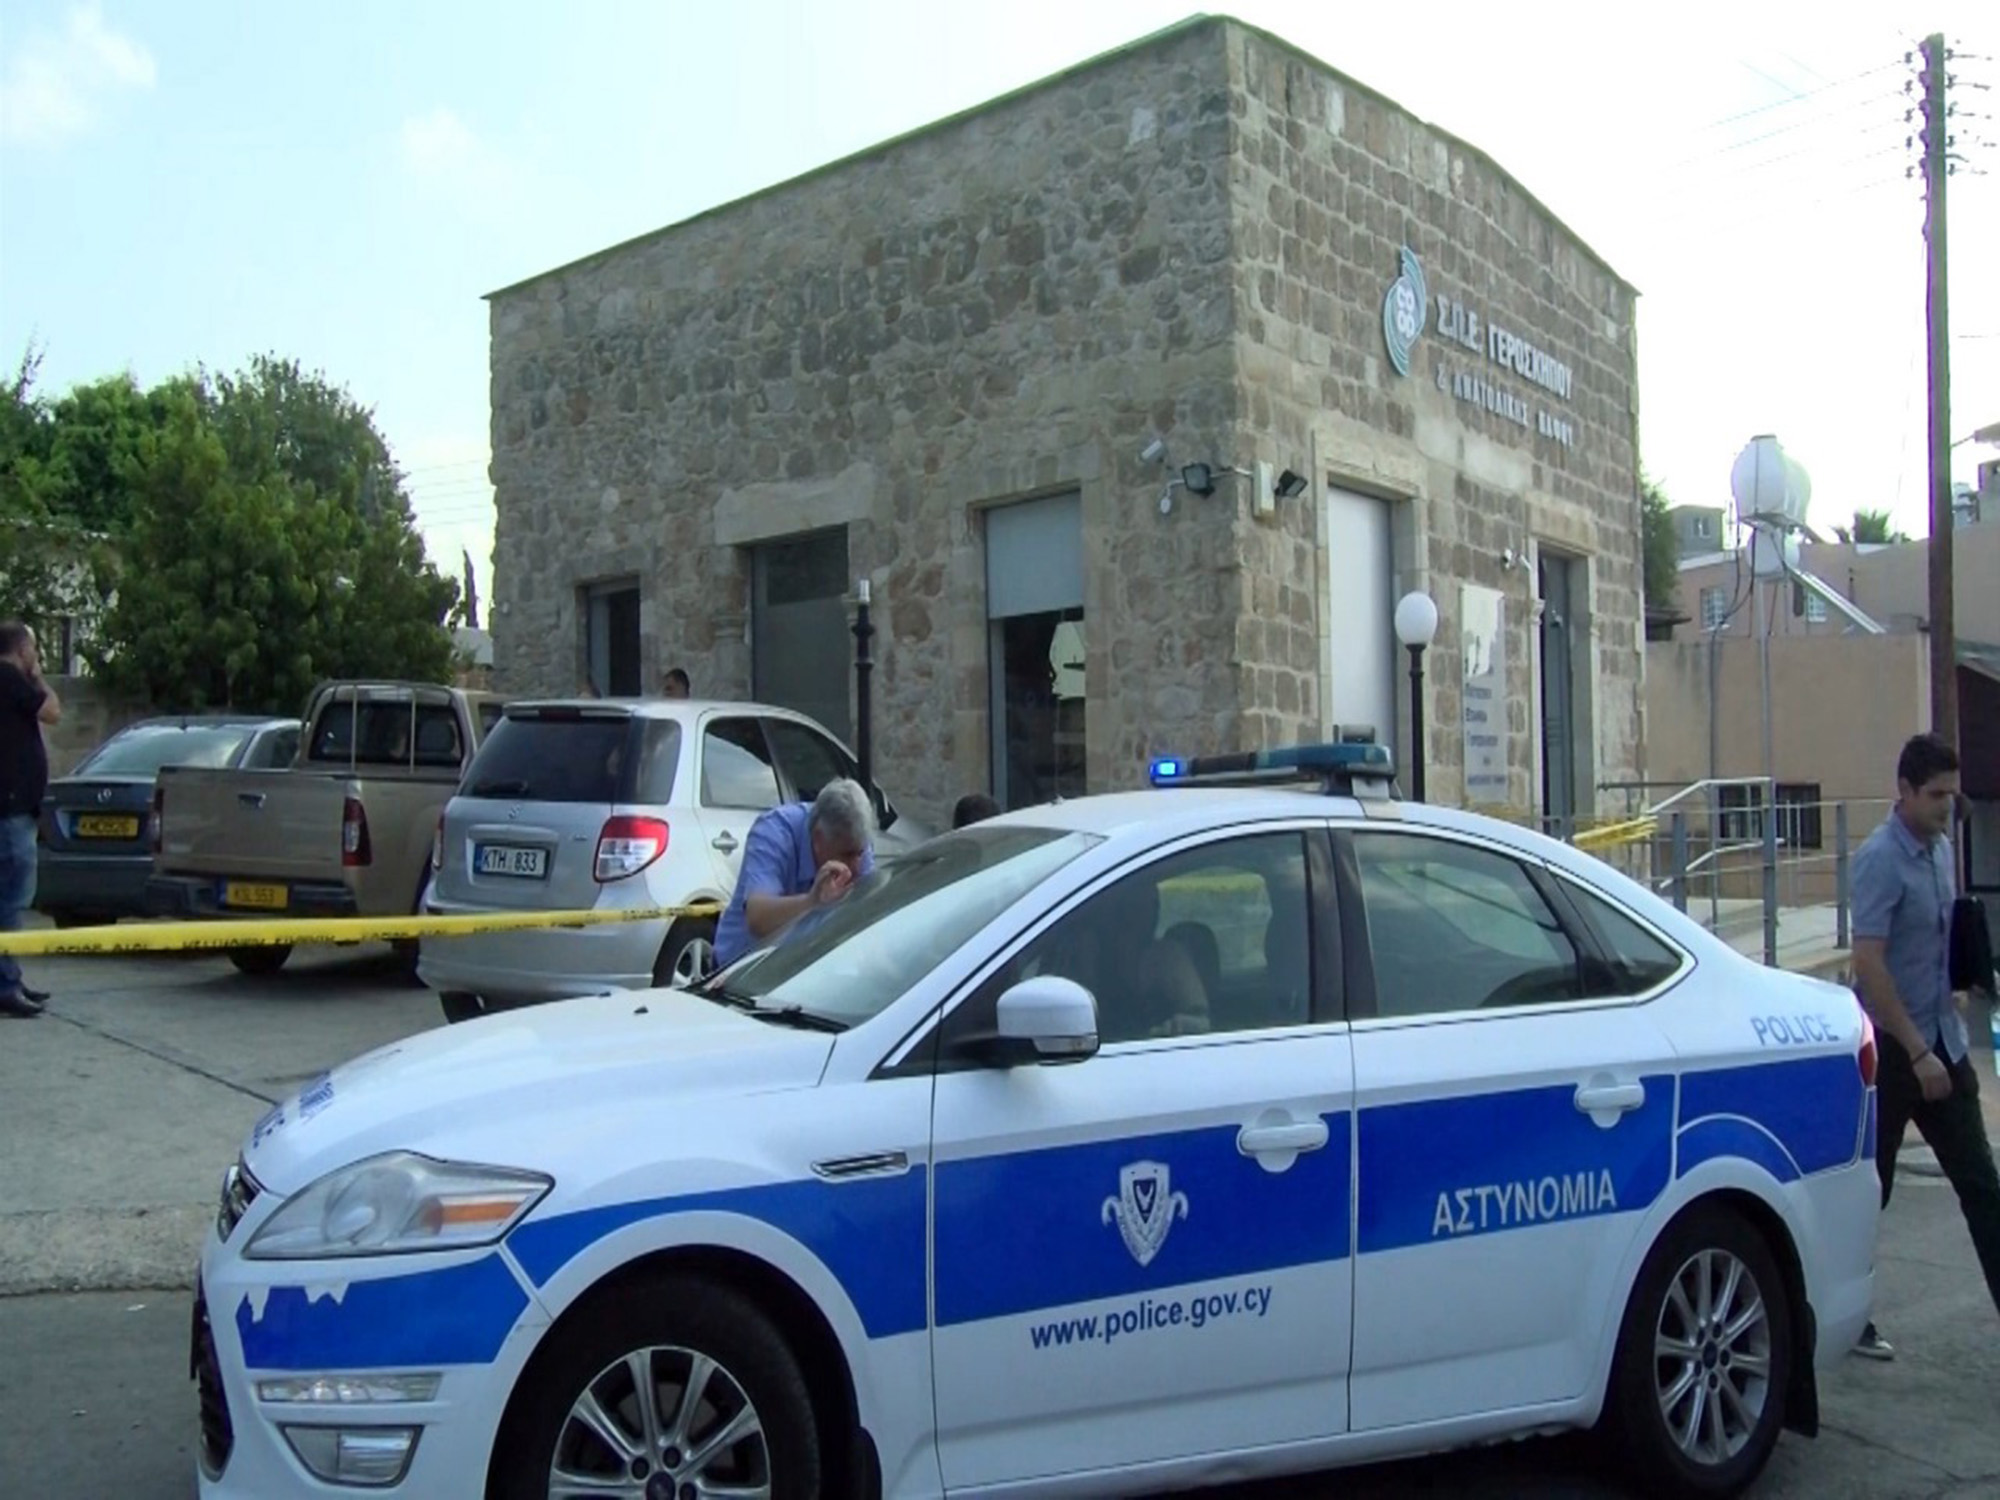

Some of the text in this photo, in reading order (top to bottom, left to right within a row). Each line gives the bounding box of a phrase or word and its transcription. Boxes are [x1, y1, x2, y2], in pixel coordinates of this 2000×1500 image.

[1488, 322, 1573, 400] ΓΕΡΟΣΚΗΠΟΥ
[481, 847, 538, 873] KTH 833
[1750, 1013, 1840, 1047] POLICE
[1431, 1167, 1617, 1238] ΑΣΤΥΝΟΜΙΑ
[1030, 1285, 1272, 1349] www.police.gov.cy
